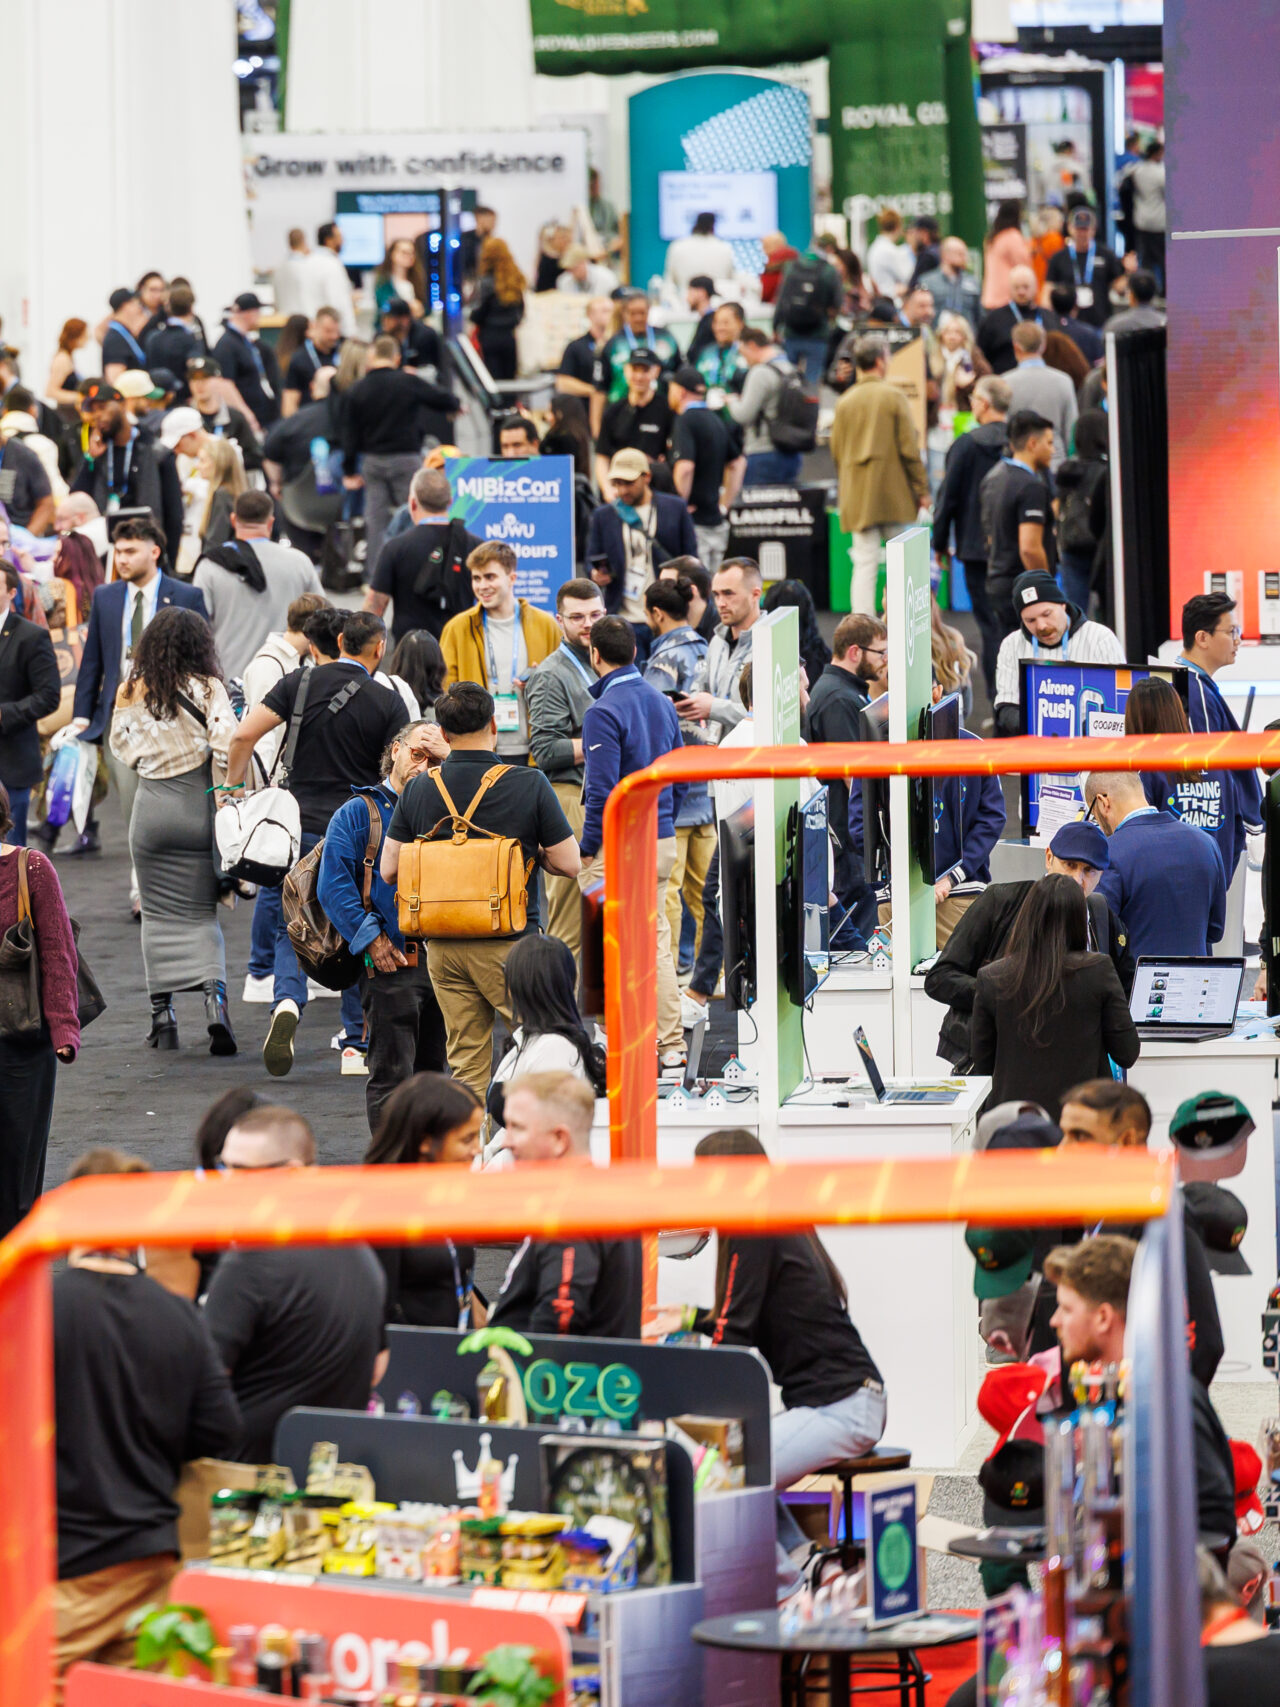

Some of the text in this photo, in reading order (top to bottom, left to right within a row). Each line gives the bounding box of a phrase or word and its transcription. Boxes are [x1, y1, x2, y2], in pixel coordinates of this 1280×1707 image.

[842, 103, 914, 130] ROYAL
[254, 151, 566, 177] Grow with confidence
[457, 476, 561, 500] MJBizCon
[742, 488, 801, 503] LANDFILL
[729, 508, 815, 525] LANDFILL
[485, 523, 535, 539] NUWU
[1038, 678, 1075, 696] Airone
[1038, 698, 1075, 719] Rush
[1093, 720, 1124, 732] GOODBYE
[1176, 781, 1221, 799] LEADING
[1178, 797, 1220, 815] THE
[1179, 811, 1220, 828] CHANGE
[523, 1358, 642, 1419] oze
